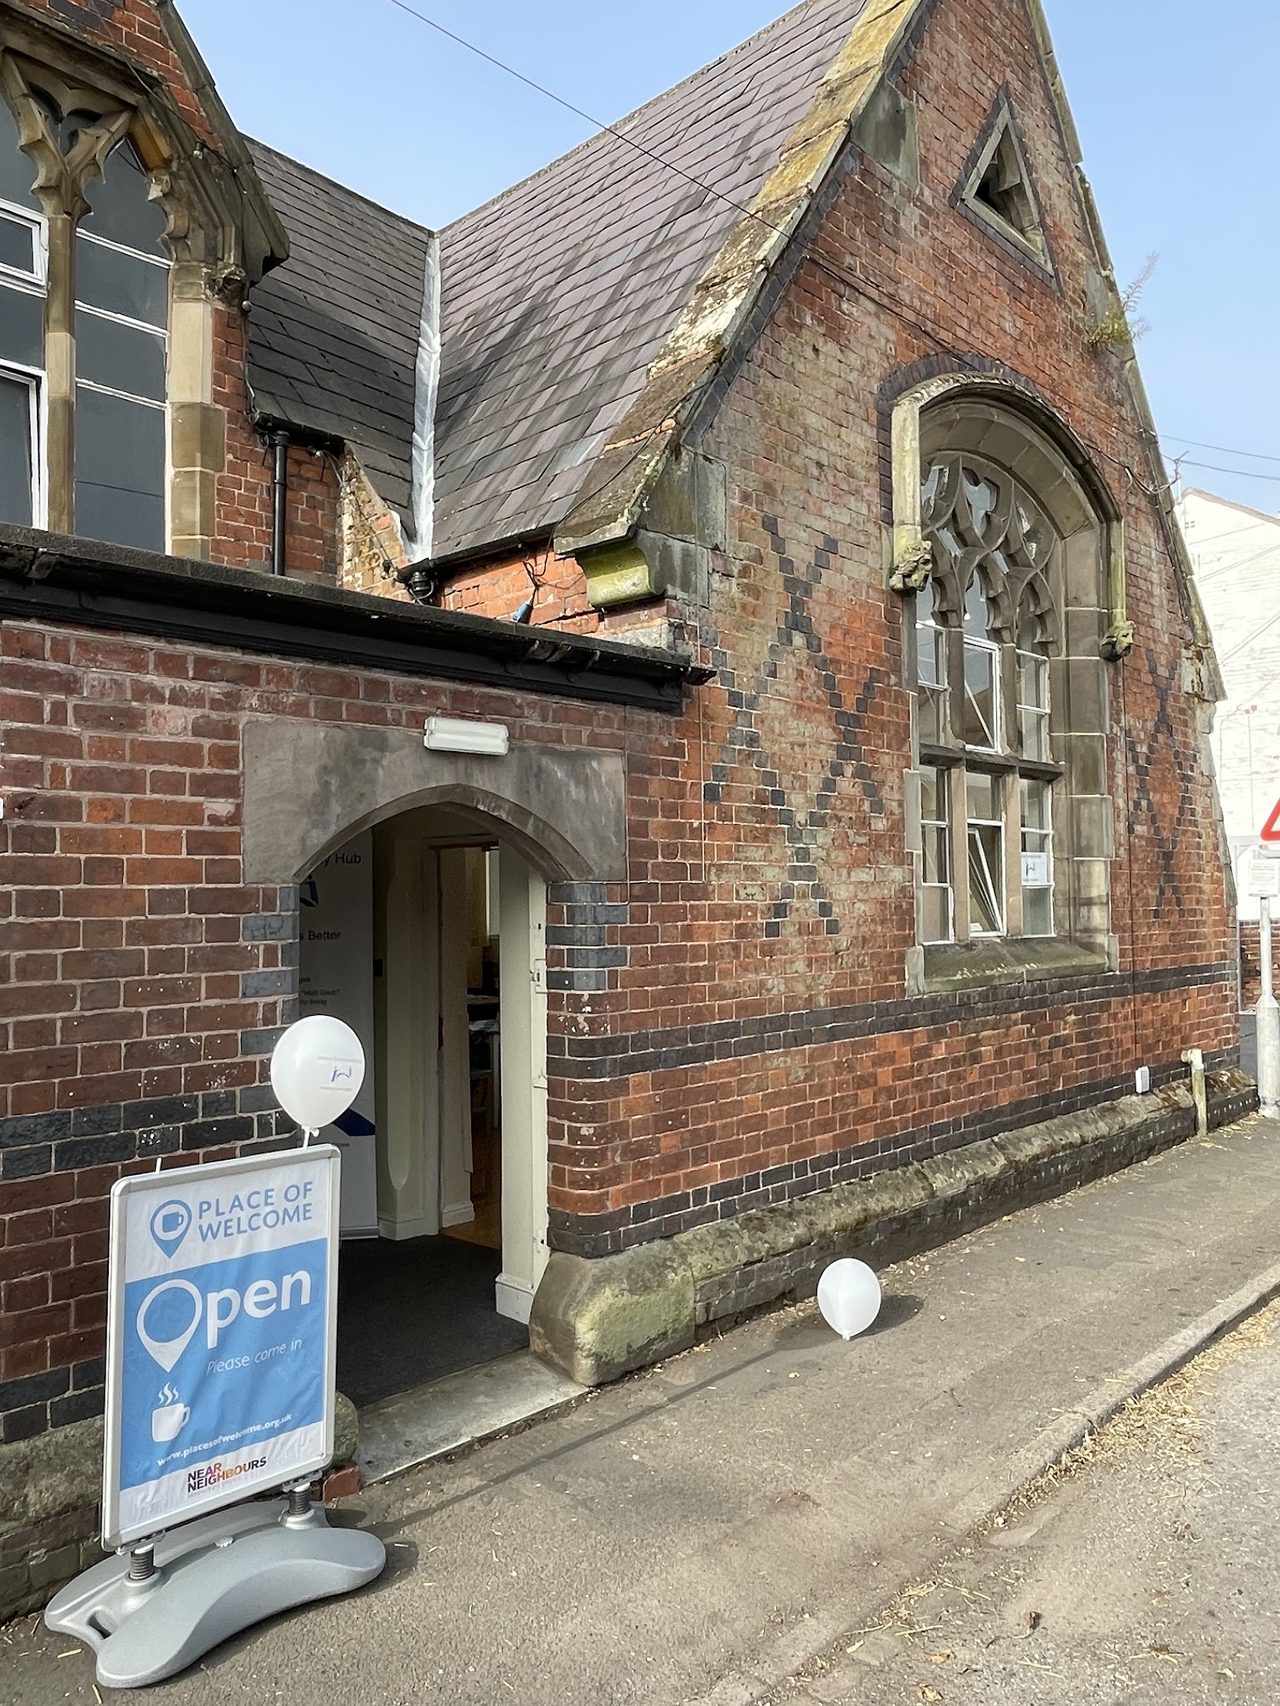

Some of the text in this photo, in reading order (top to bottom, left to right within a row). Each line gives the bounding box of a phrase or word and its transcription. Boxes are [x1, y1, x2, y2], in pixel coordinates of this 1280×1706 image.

[335, 852, 362, 865] Hub
[308, 930, 341, 941] Better
[198, 1181, 313, 1219] PLACE OF
[198, 1203, 313, 1242] WELCOME
[136, 1269, 312, 1373] Open
[206, 1337, 303, 1376] Please come in
[156, 1413, 293, 1467] www.placesofwelcome.org.uk
[187, 1462, 222, 1482] NEAR
[187, 1456, 267, 1493] NEIGHBOURS
